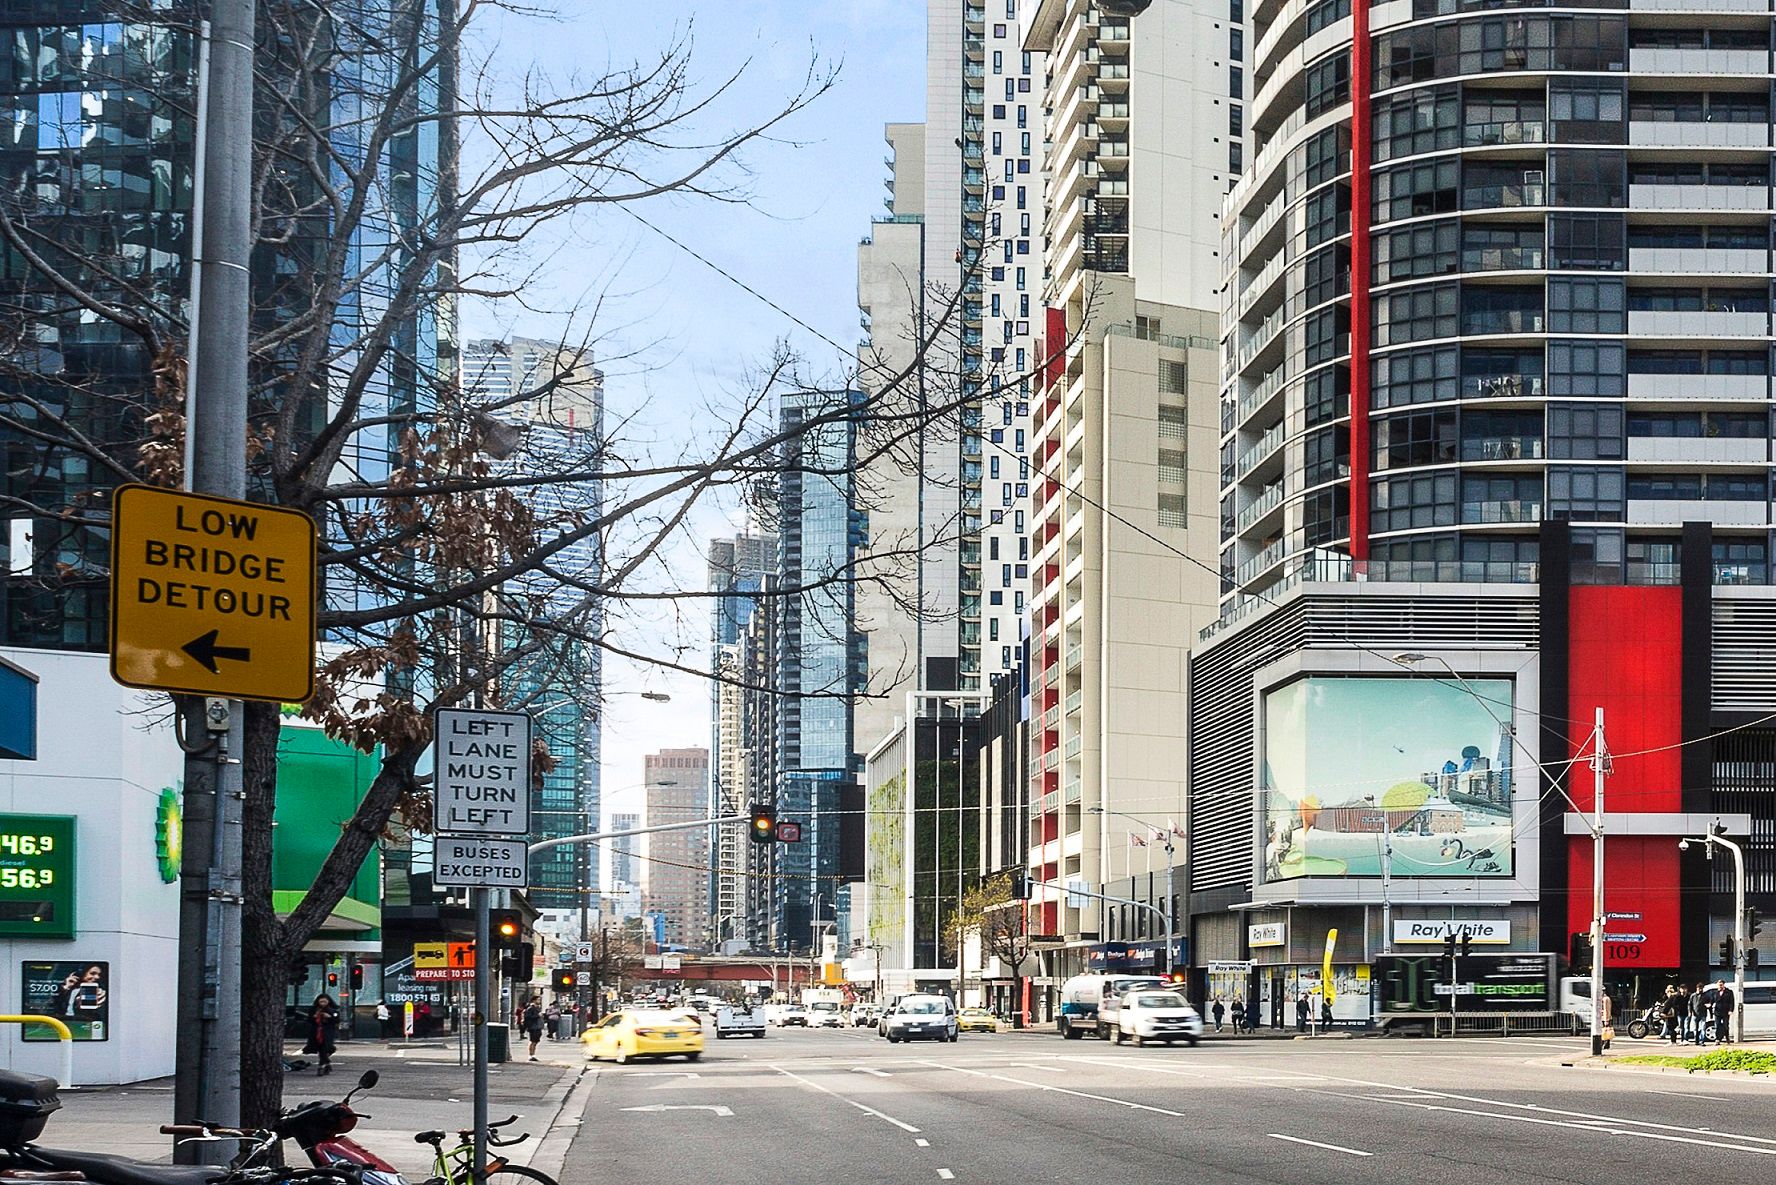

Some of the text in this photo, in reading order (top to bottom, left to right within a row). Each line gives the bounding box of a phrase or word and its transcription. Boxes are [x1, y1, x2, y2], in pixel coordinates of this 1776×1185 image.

[176, 505, 258, 541] LOW
[145, 539, 286, 583] BRIDGE
[137, 577, 291, 621] DETOUR
[452, 719, 514, 737] LEFT
[449, 741, 517, 759] LANE
[448, 763, 518, 781] MUST
[450, 785, 516, 803] TURN
[451, 807, 513, 824] LEFT
[0, 834, 53, 855] 46.9
[453, 846, 511, 860] BUSES
[0, 868, 53, 888] 56.9
[440, 864, 522, 879] EXCEPTED
[1253, 928, 1262, 940] Ray
[1411, 924, 1494, 938] Ray White
[1609, 944, 1641, 960] 109
[415, 969, 475, 978] PREPARE TO STO
[29, 983, 58, 993] $7.00
[397, 984, 425, 993] leasing
[390, 993, 413, 1002] 1800
